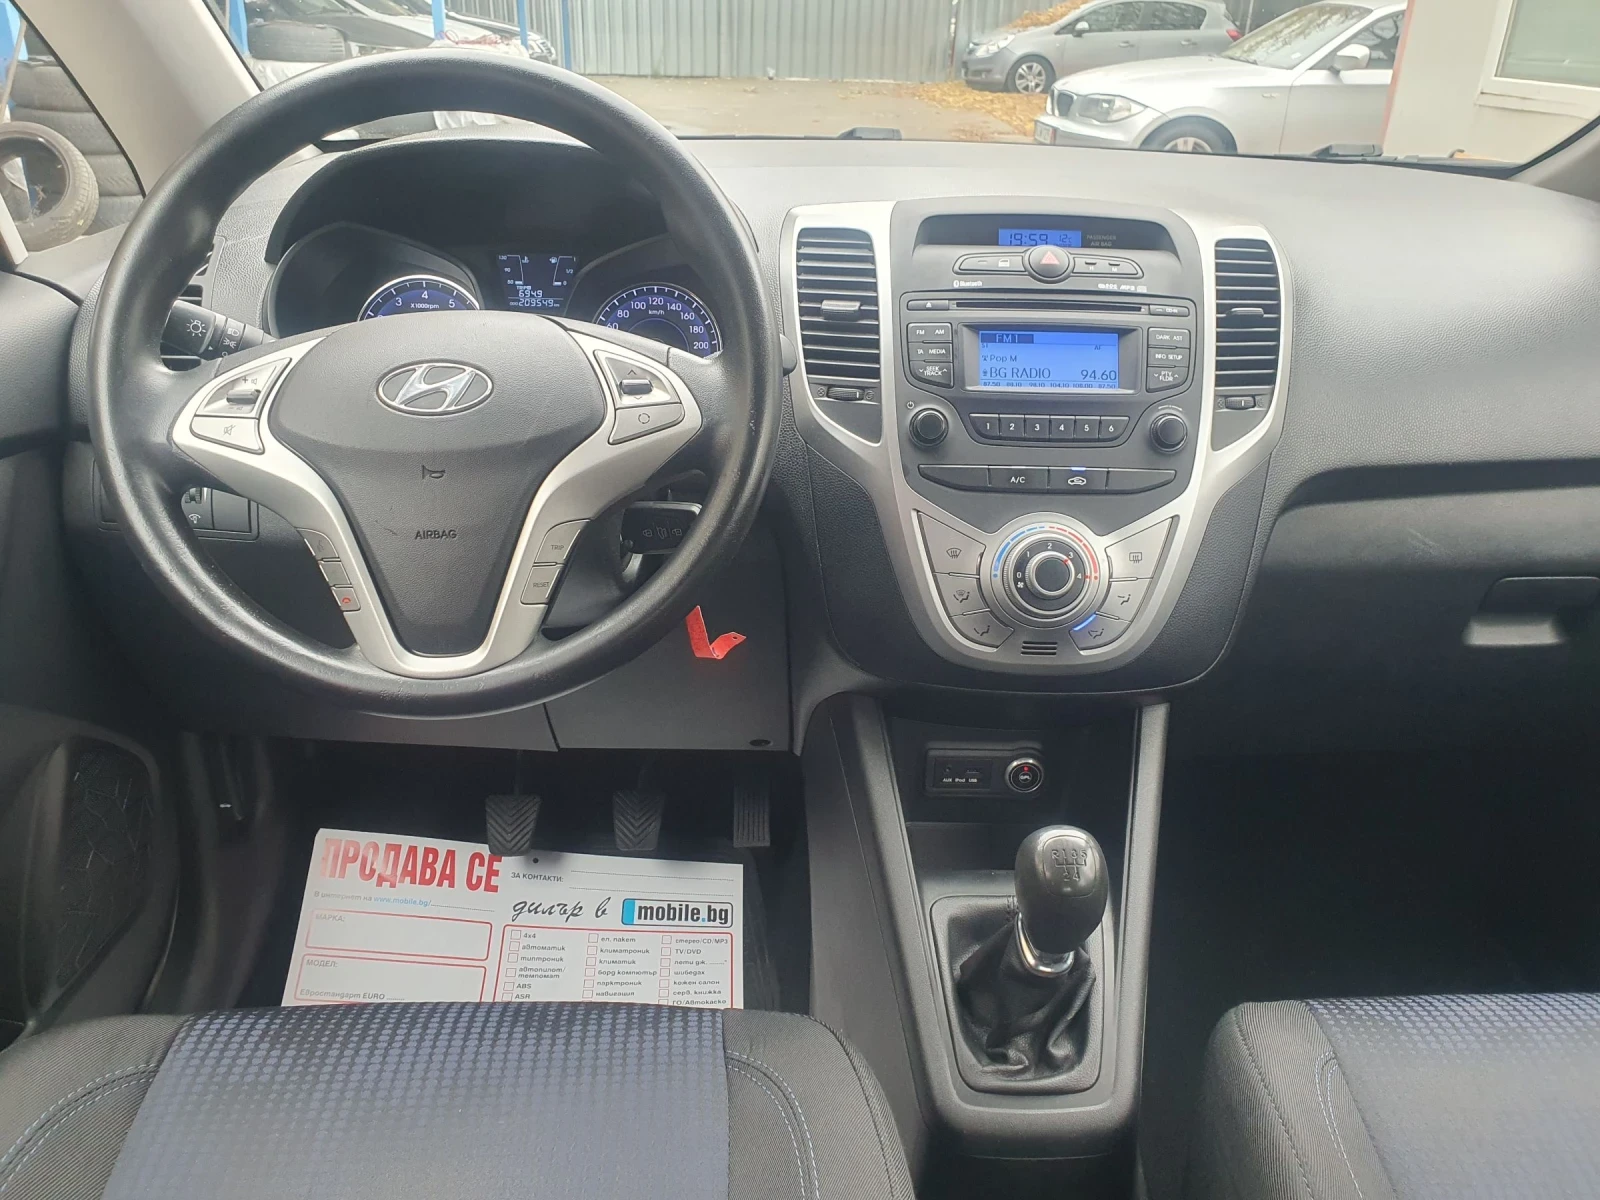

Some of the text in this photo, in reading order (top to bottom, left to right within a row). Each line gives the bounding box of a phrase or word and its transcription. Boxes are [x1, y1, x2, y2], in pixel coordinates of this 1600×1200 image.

[1009, 233, 1048, 246] 19:59
[421, 291, 428, 299] 4
[395, 298, 402, 306] 3
[448, 299, 455, 308] 5
[519, 299, 554, 307] 209549
[631, 301, 646, 310] 100
[648, 297, 664, 305] 120
[667, 303, 681, 311] 140
[617, 310, 629, 318] 80
[680, 312, 695, 320] 160
[689, 325, 704, 334] 180
[693, 341, 709, 350] 200
[990, 355, 1007, 363] Pop
[990, 367, 1117, 380] BG RADIO 94.60
[414, 529, 457, 540] AIRBAG
[1052, 849, 1059, 859] R
[1071, 849, 1078, 859] 3
[1081, 850, 1087, 859] 5
[320, 838, 503, 893] ПРОДАВА СЕ
[522, 873, 564, 883] КОНТАКТИ:
[1063, 871, 1080, 881] 2 4
[321, 892, 362, 901] интернет
[511, 899, 584, 923] дилър
[637, 903, 728, 924] mobile.bg
[315, 913, 345, 922] МАРКА:
[306, 959, 338, 968] МОДЕЛ:
[300, 988, 385, 1000] Евростандарт EURO
